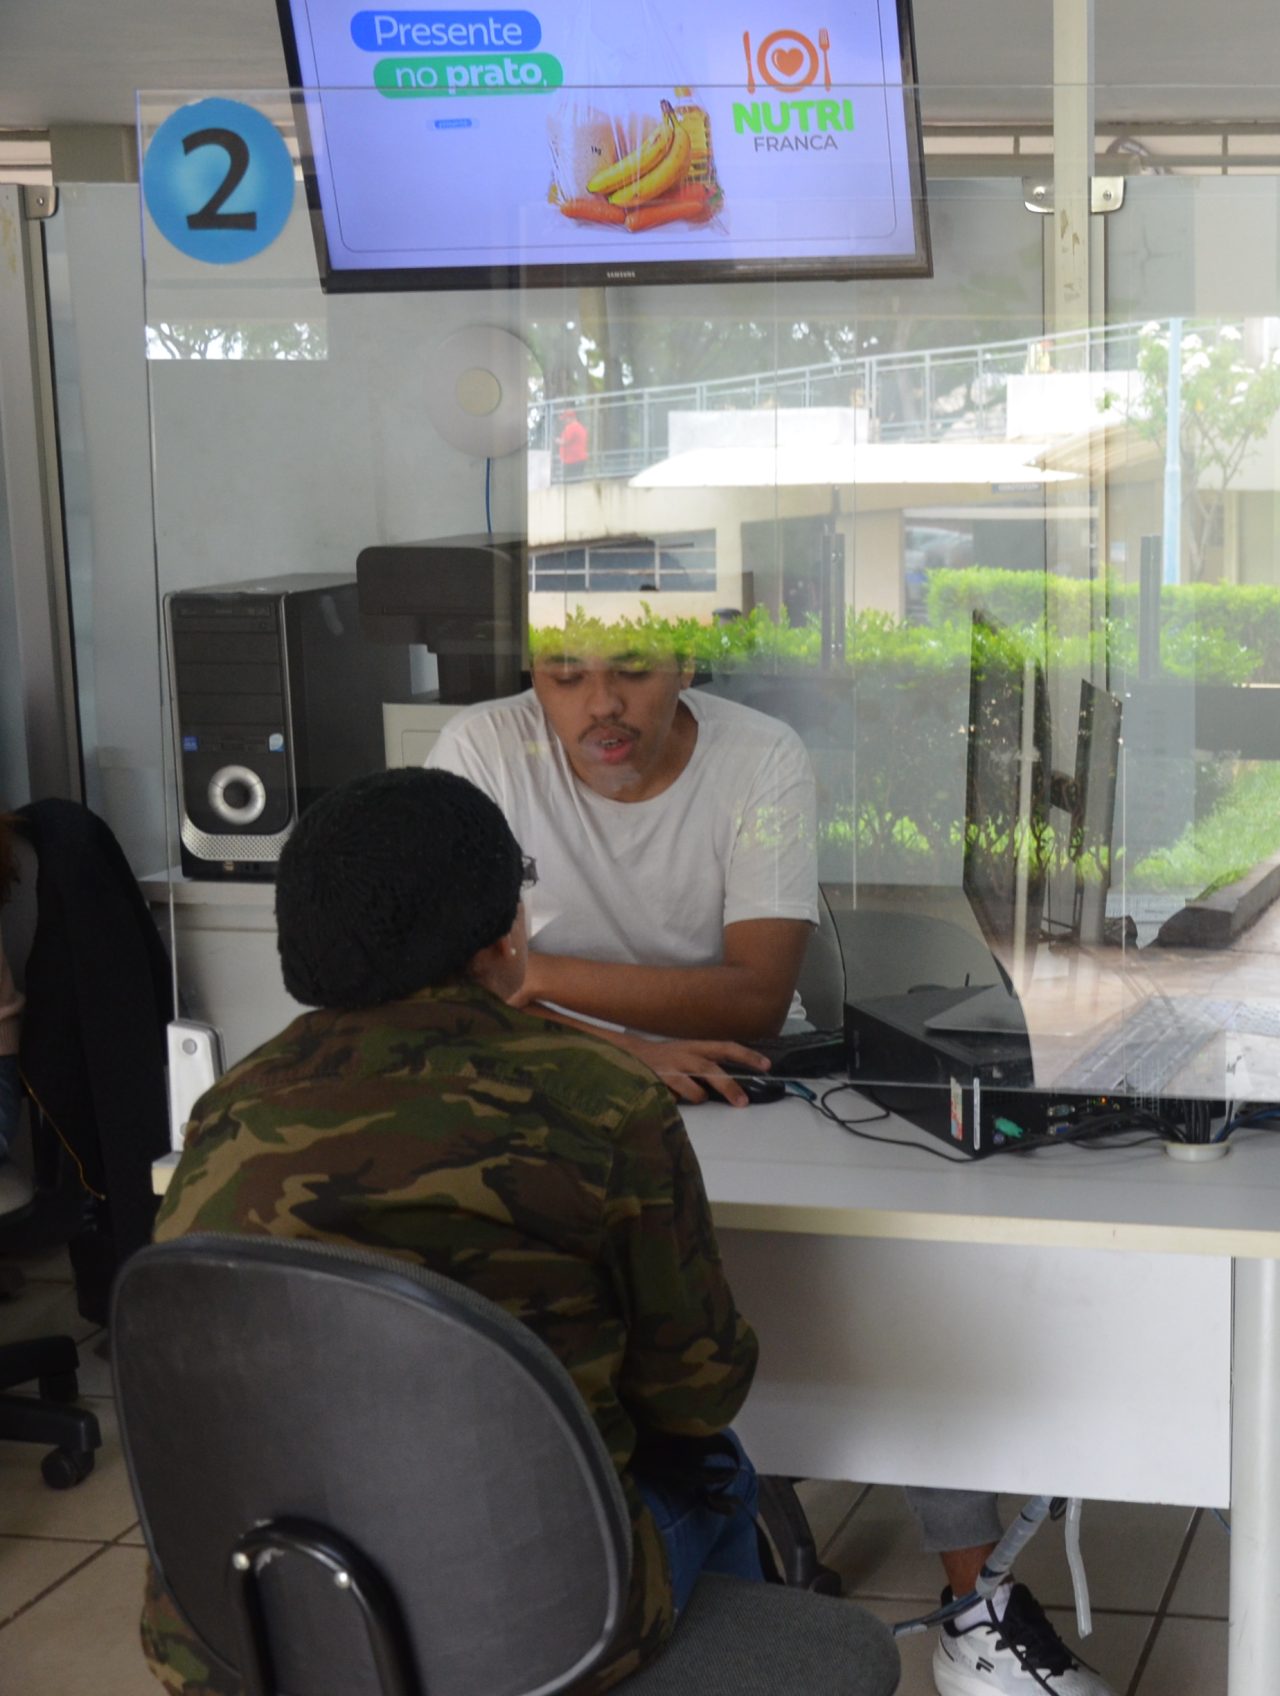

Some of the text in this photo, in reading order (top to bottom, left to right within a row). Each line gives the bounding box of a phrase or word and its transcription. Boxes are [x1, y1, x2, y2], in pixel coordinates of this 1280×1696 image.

[374, 15, 523, 46] Presente
[395, 66, 438, 88] no
[732, 99, 855, 134] NUTRI
[754, 134, 838, 152] FRANCA
[182, 127, 257, 231] 2
[606, 271, 636, 279] SAMSUNG
